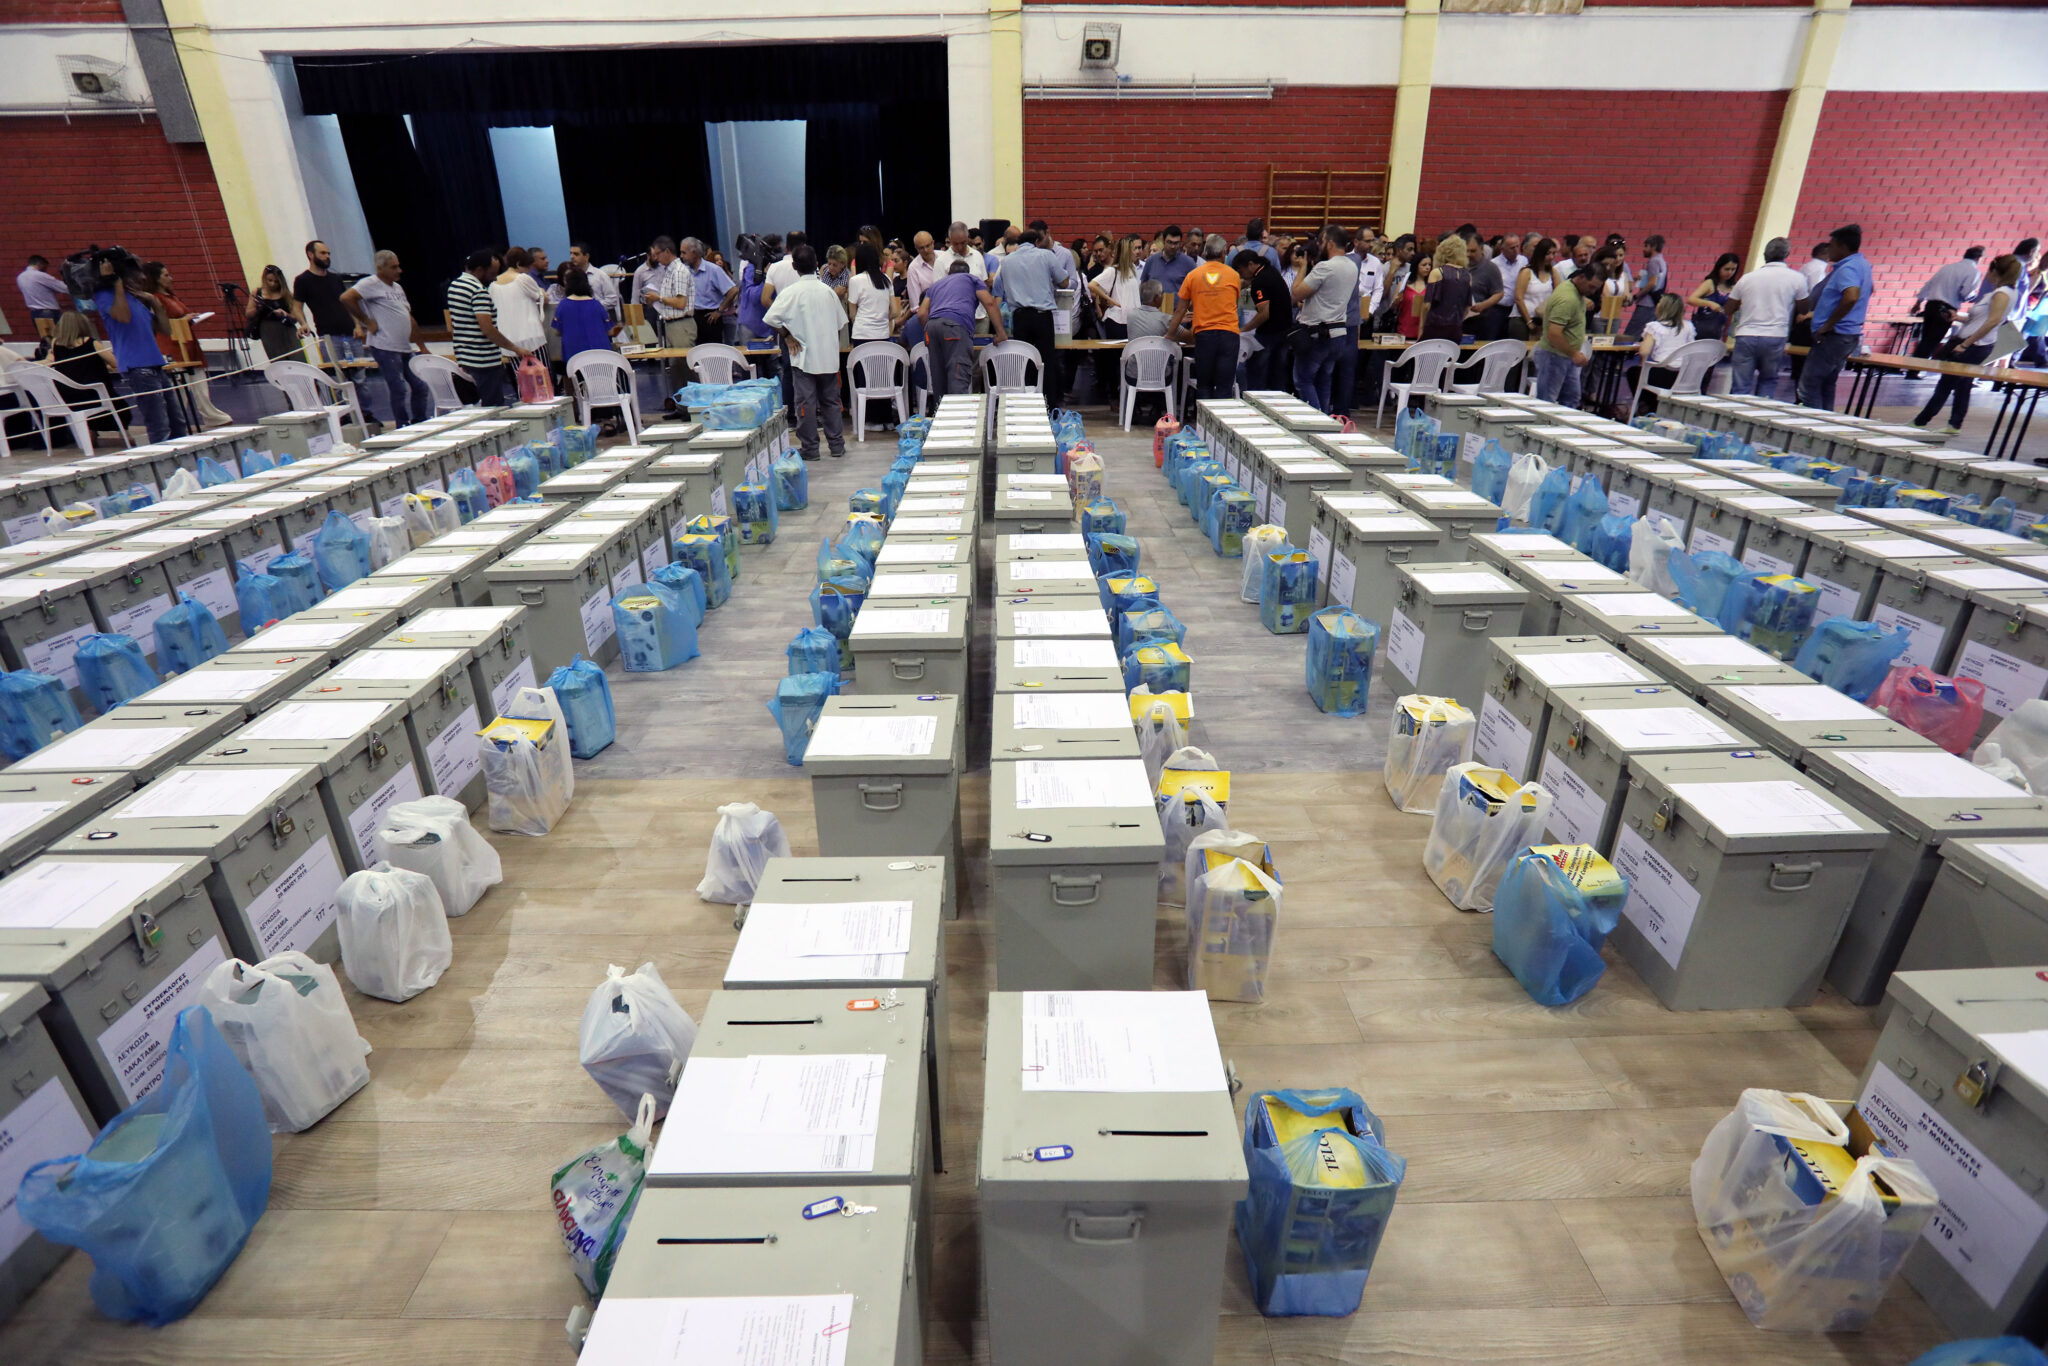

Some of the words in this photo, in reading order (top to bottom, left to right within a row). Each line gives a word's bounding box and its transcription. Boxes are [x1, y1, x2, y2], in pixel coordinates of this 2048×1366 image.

[1256, 289, 1264, 300] 3
[315, 907, 326, 922] 177
[1648, 919, 1660, 933] 117
[117, 1031, 150, 1063] ΛΕΥΚΩΣΙΑ
[123, 1039, 161, 1077] ΛΑΚΑΤΑΜΙΑ
[135, 1073, 163, 1101] ΚΕΝΤΡΟ
[1870, 1093, 1909, 1132] ΛΕΥΚΩΣΙΑ
[1863, 1106, 1910, 1153] ΣΤΡΟΒΟΛΟΣ
[1921, 1112, 1984, 1171] ΕΥΡΩΕΚΛΟΓΕΣ
[1917, 1119, 1928, 1132] 26
[1957, 1155, 1979, 1179] 2019
[1932, 1215, 1954, 1241] 119
